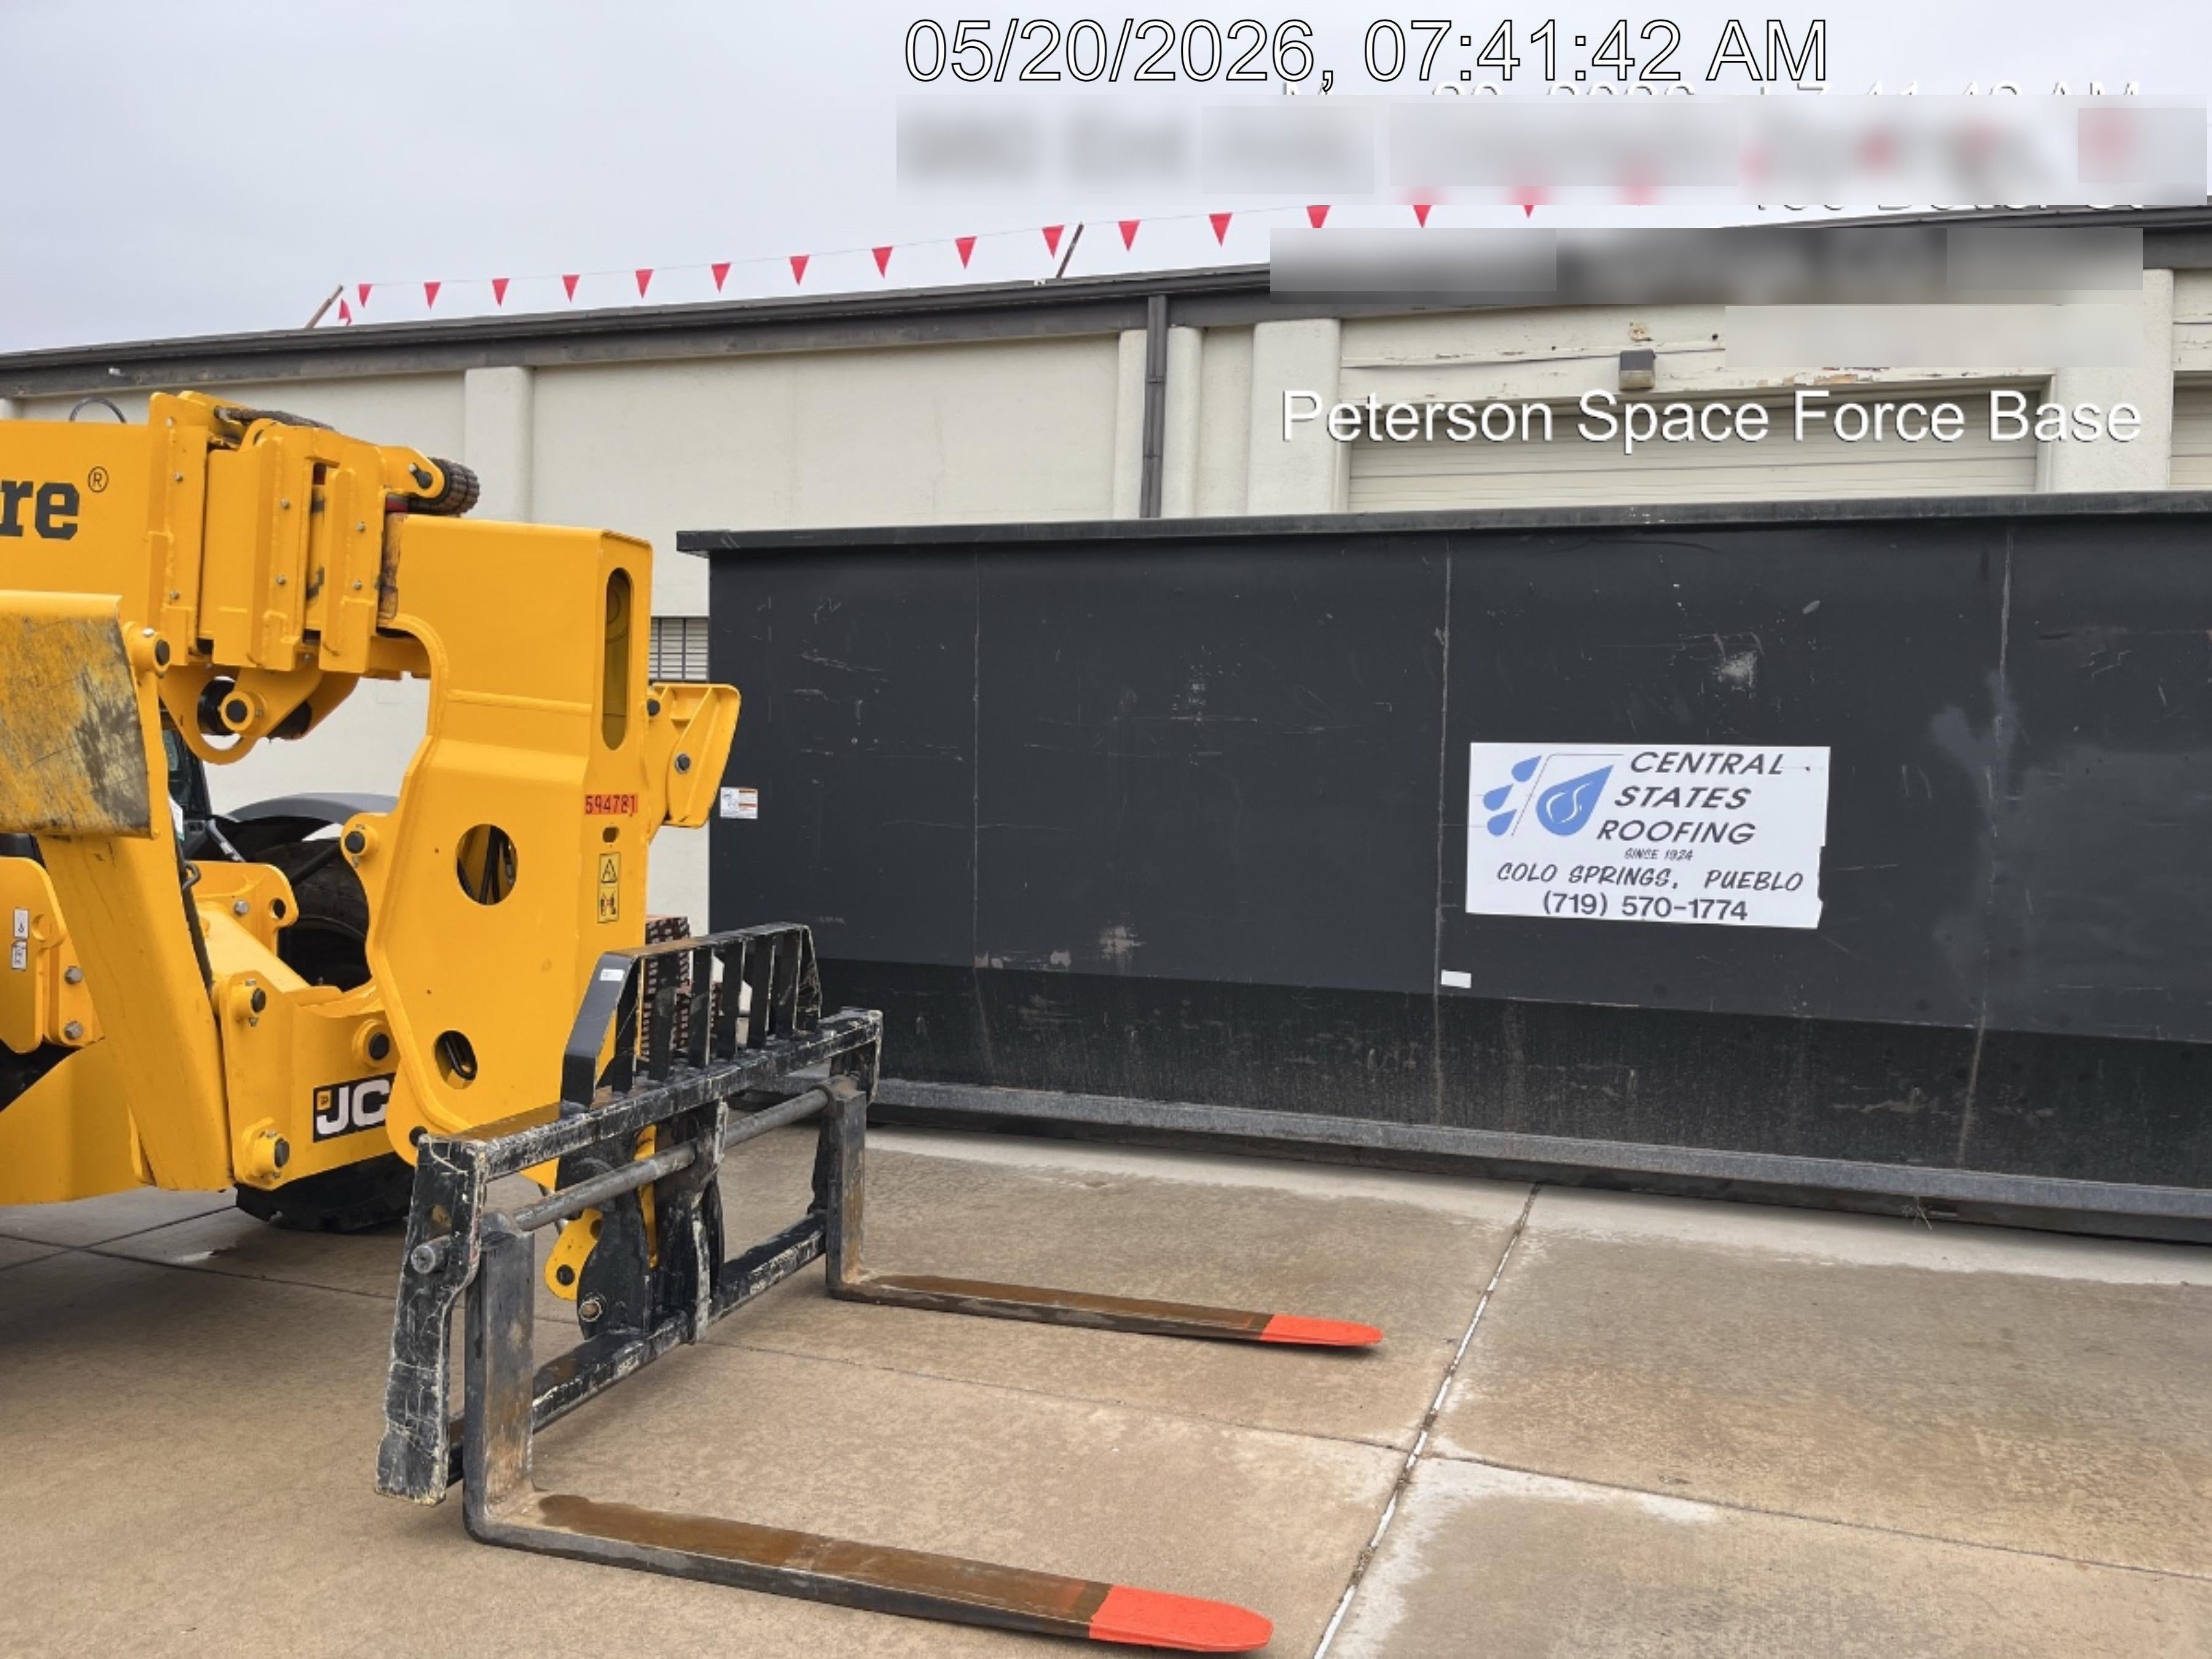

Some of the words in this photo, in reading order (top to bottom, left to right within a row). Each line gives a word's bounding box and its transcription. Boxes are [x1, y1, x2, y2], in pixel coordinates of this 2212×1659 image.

[1630, 751, 1785, 775] CENTRAL
[585, 794, 635, 814] 594781
[1614, 785, 1752, 810] STATES
[1596, 819, 1756, 845] ROOFING
[1624, 847, 1660, 860] SINCE
[1497, 862, 1558, 882] COLO
[1568, 864, 1679, 889] SPRINGS,
[1703, 869, 1804, 892] PUEBLO
[1542, 889, 1608, 917] (719)
[1621, 895, 1748, 921] 570-1774
